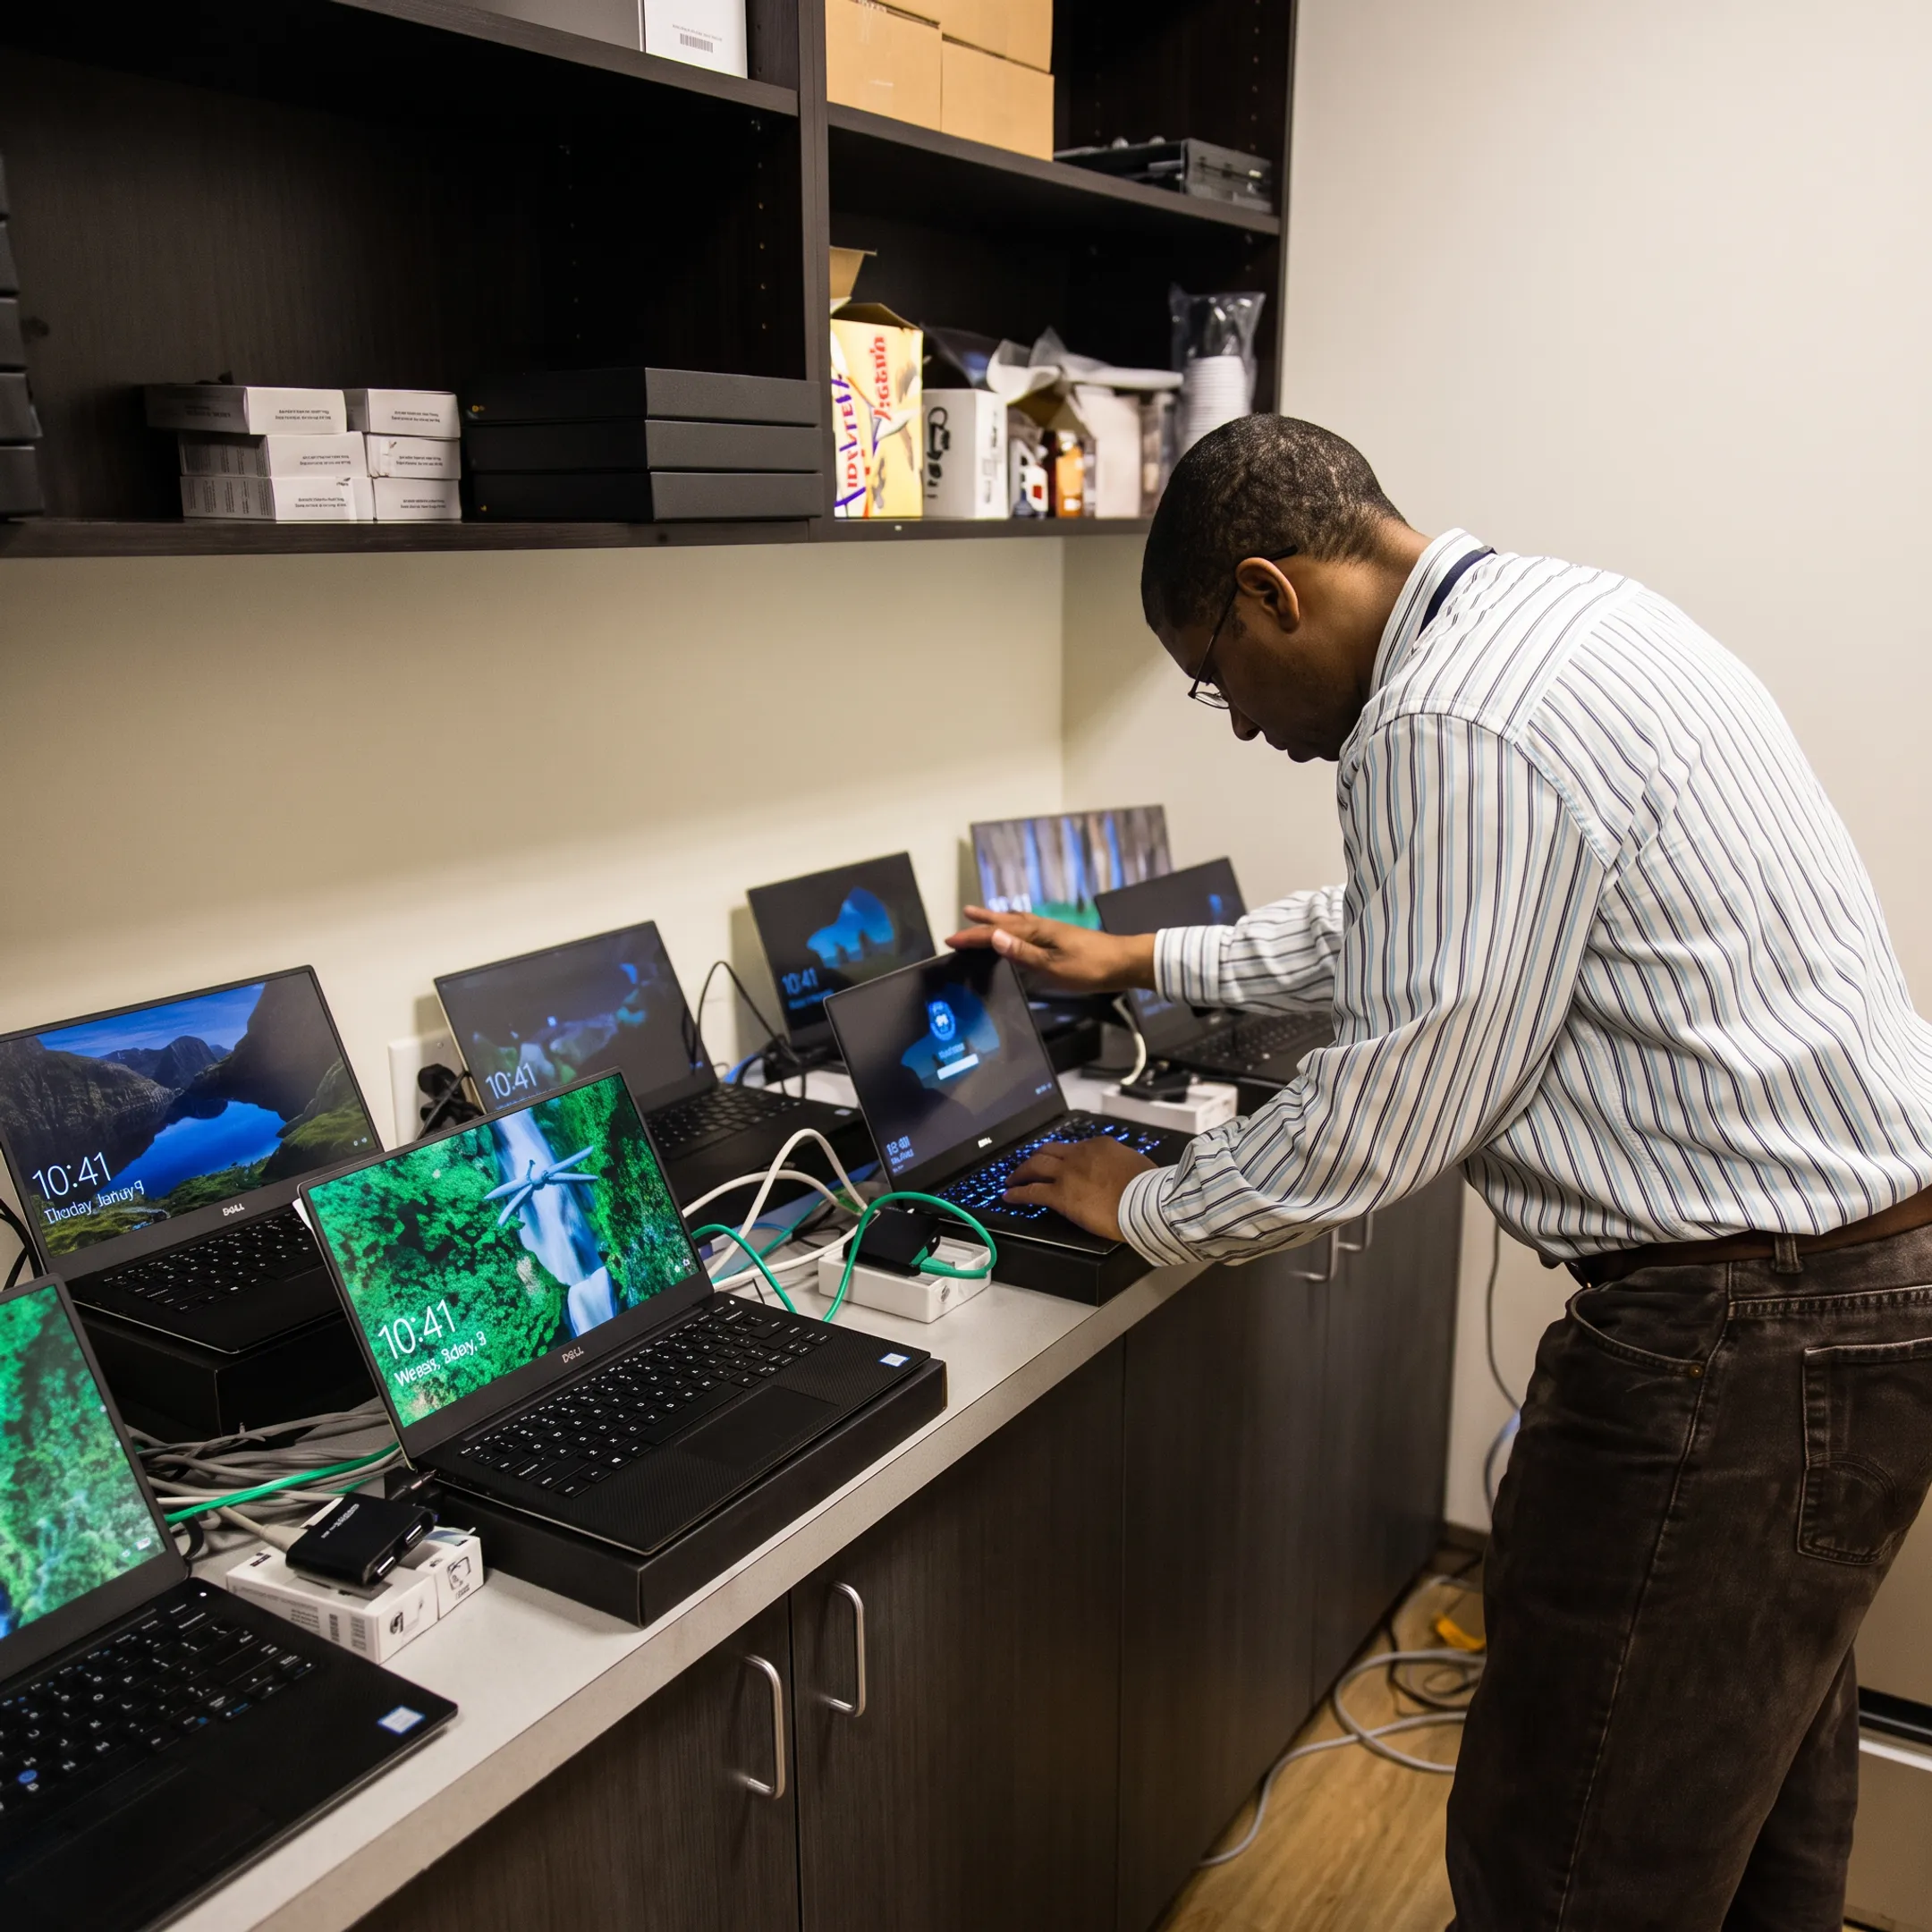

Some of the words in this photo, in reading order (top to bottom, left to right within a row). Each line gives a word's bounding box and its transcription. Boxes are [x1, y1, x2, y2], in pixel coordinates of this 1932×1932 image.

[485, 1062, 537, 1099] 10:41
[32, 1151, 111, 1199] 10:41
[377, 1299, 456, 1360] 10:41
